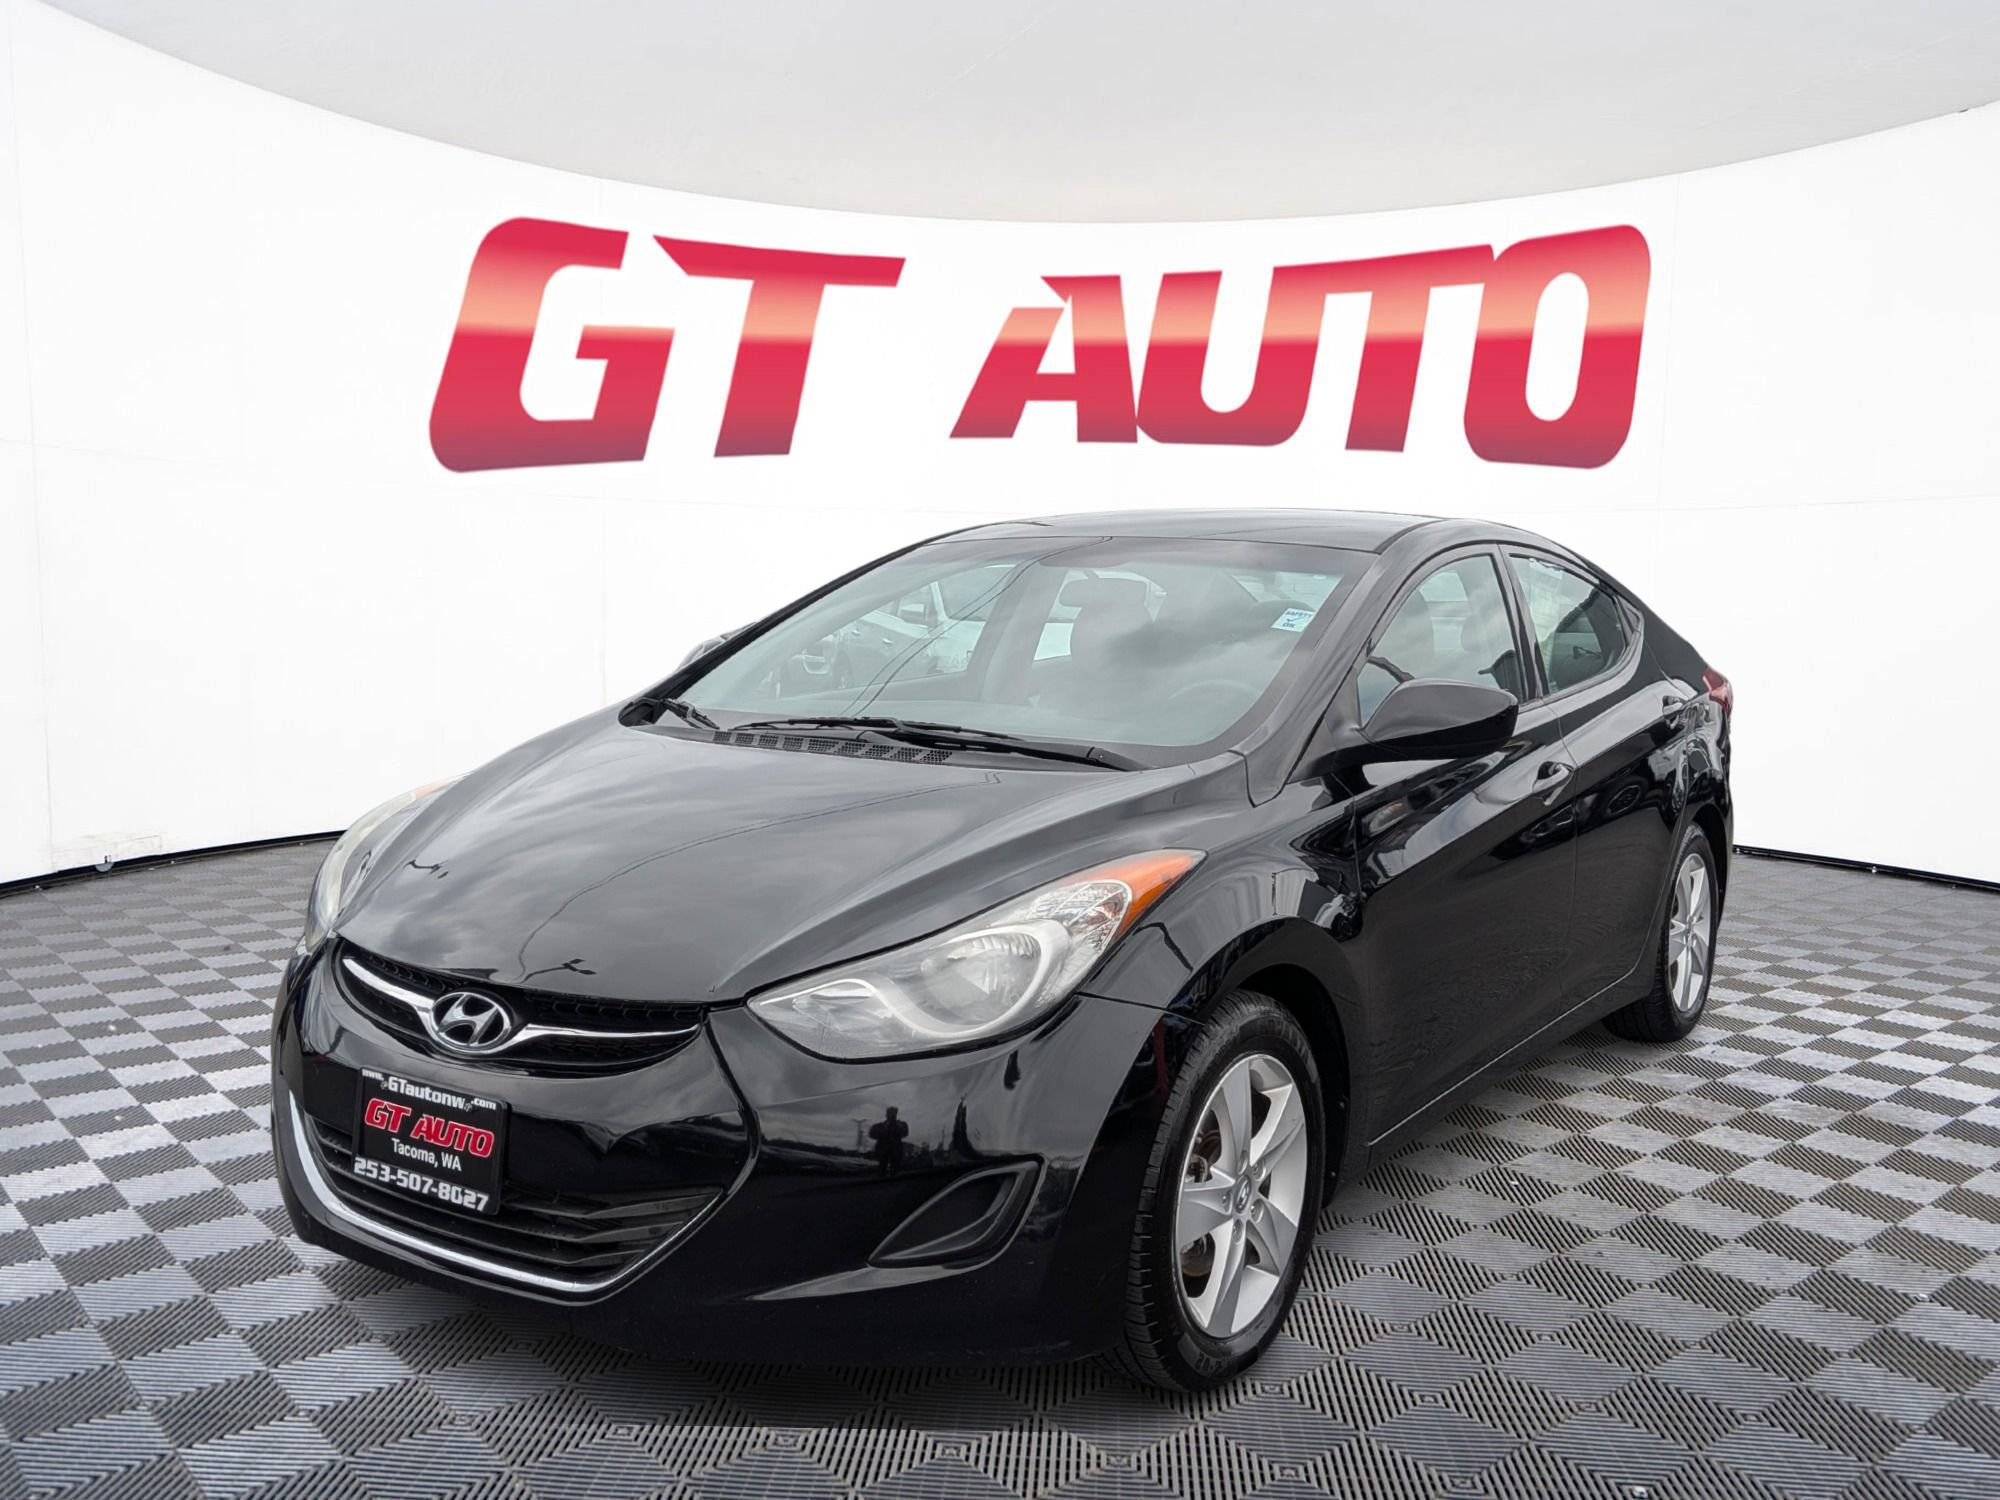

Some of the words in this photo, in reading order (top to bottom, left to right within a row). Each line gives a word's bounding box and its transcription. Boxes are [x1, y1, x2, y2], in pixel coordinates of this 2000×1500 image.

[429, 217, 905, 473] GT
[949, 224, 1651, 469] AUTO
[1285, 610, 1314, 618] SAFETY
[364, 1097, 412, 1134] GT
[410, 1113, 495, 1158] AUTO
[391, 1137, 439, 1168] Tacoma,
[441, 1151, 462, 1172] WA
[353, 1156, 489, 1212] 253-507-8027
